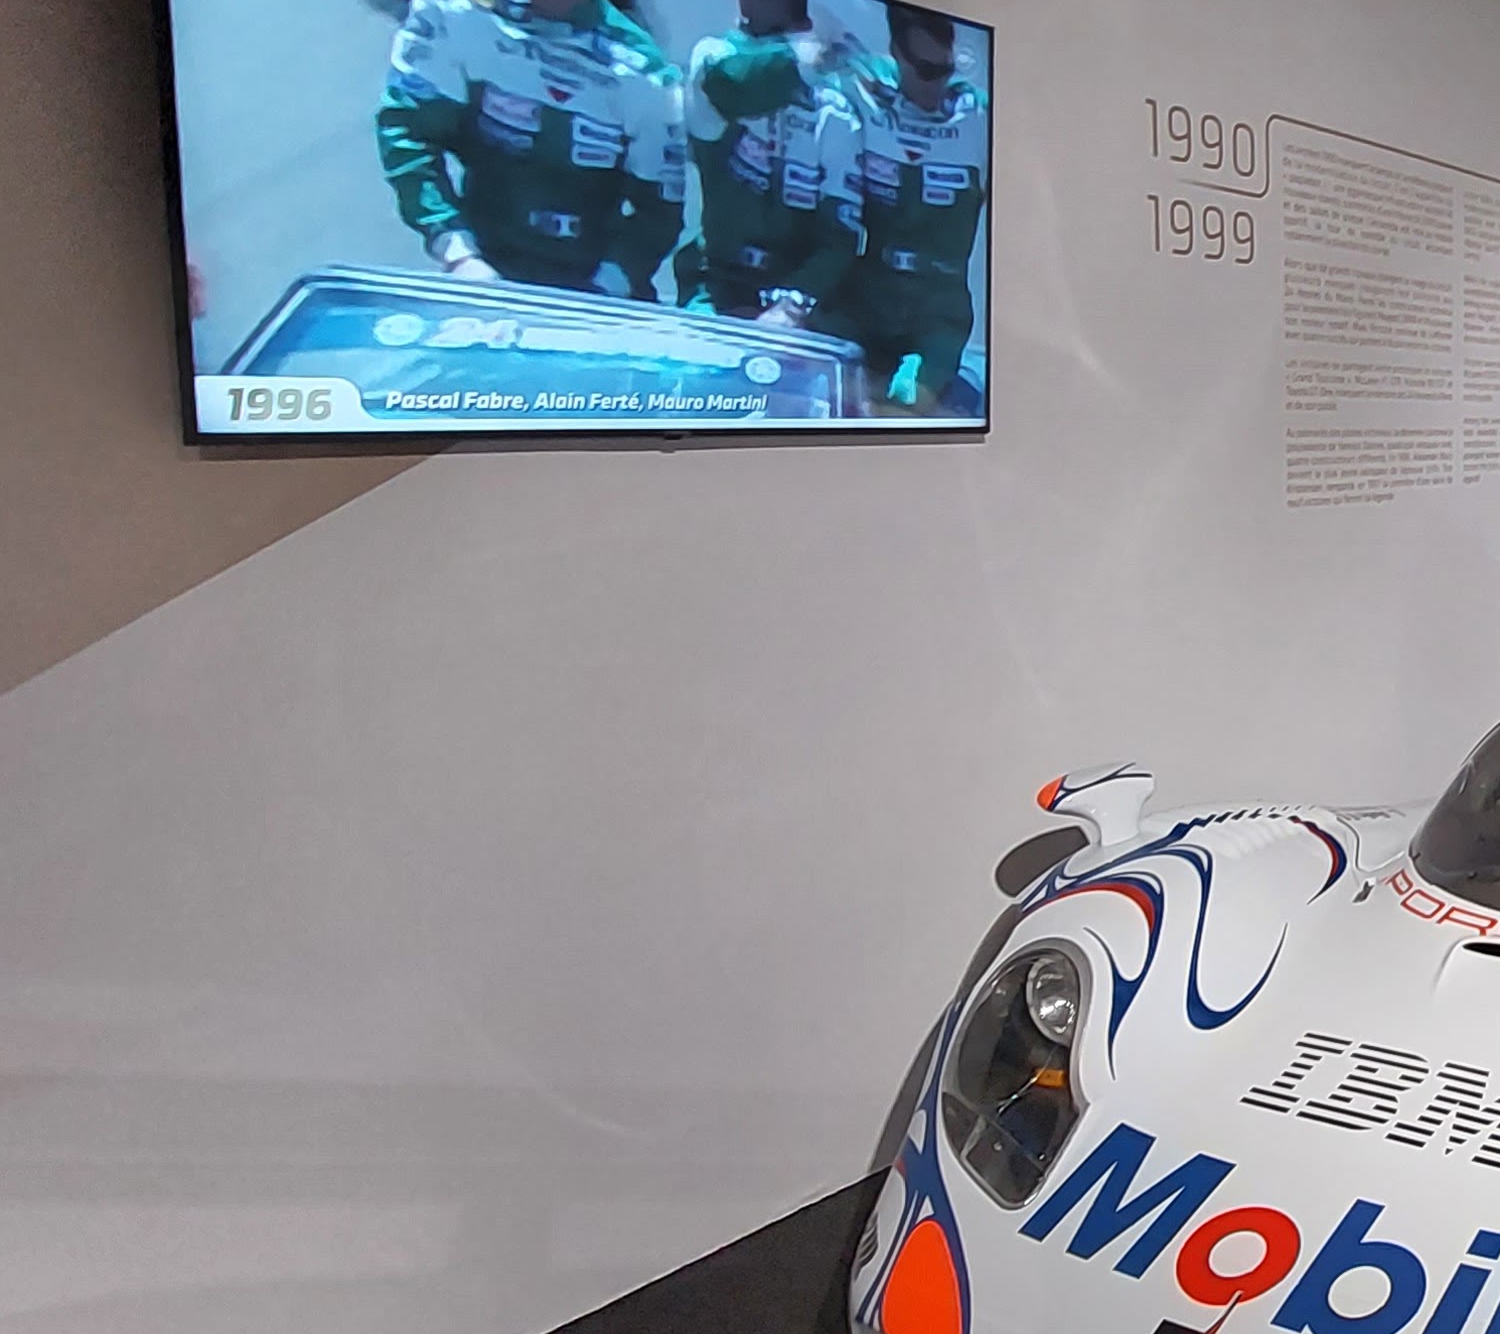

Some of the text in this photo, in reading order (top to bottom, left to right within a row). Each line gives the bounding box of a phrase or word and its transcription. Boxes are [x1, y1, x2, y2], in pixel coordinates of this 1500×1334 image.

[1145, 98, 1255, 178] 1990
[1147, 194, 1255, 265] 1999
[227, 386, 333, 422] 1996
[385, 390, 768, 413] Pascal Fabre, Alain Ferté, Mauro Martini
